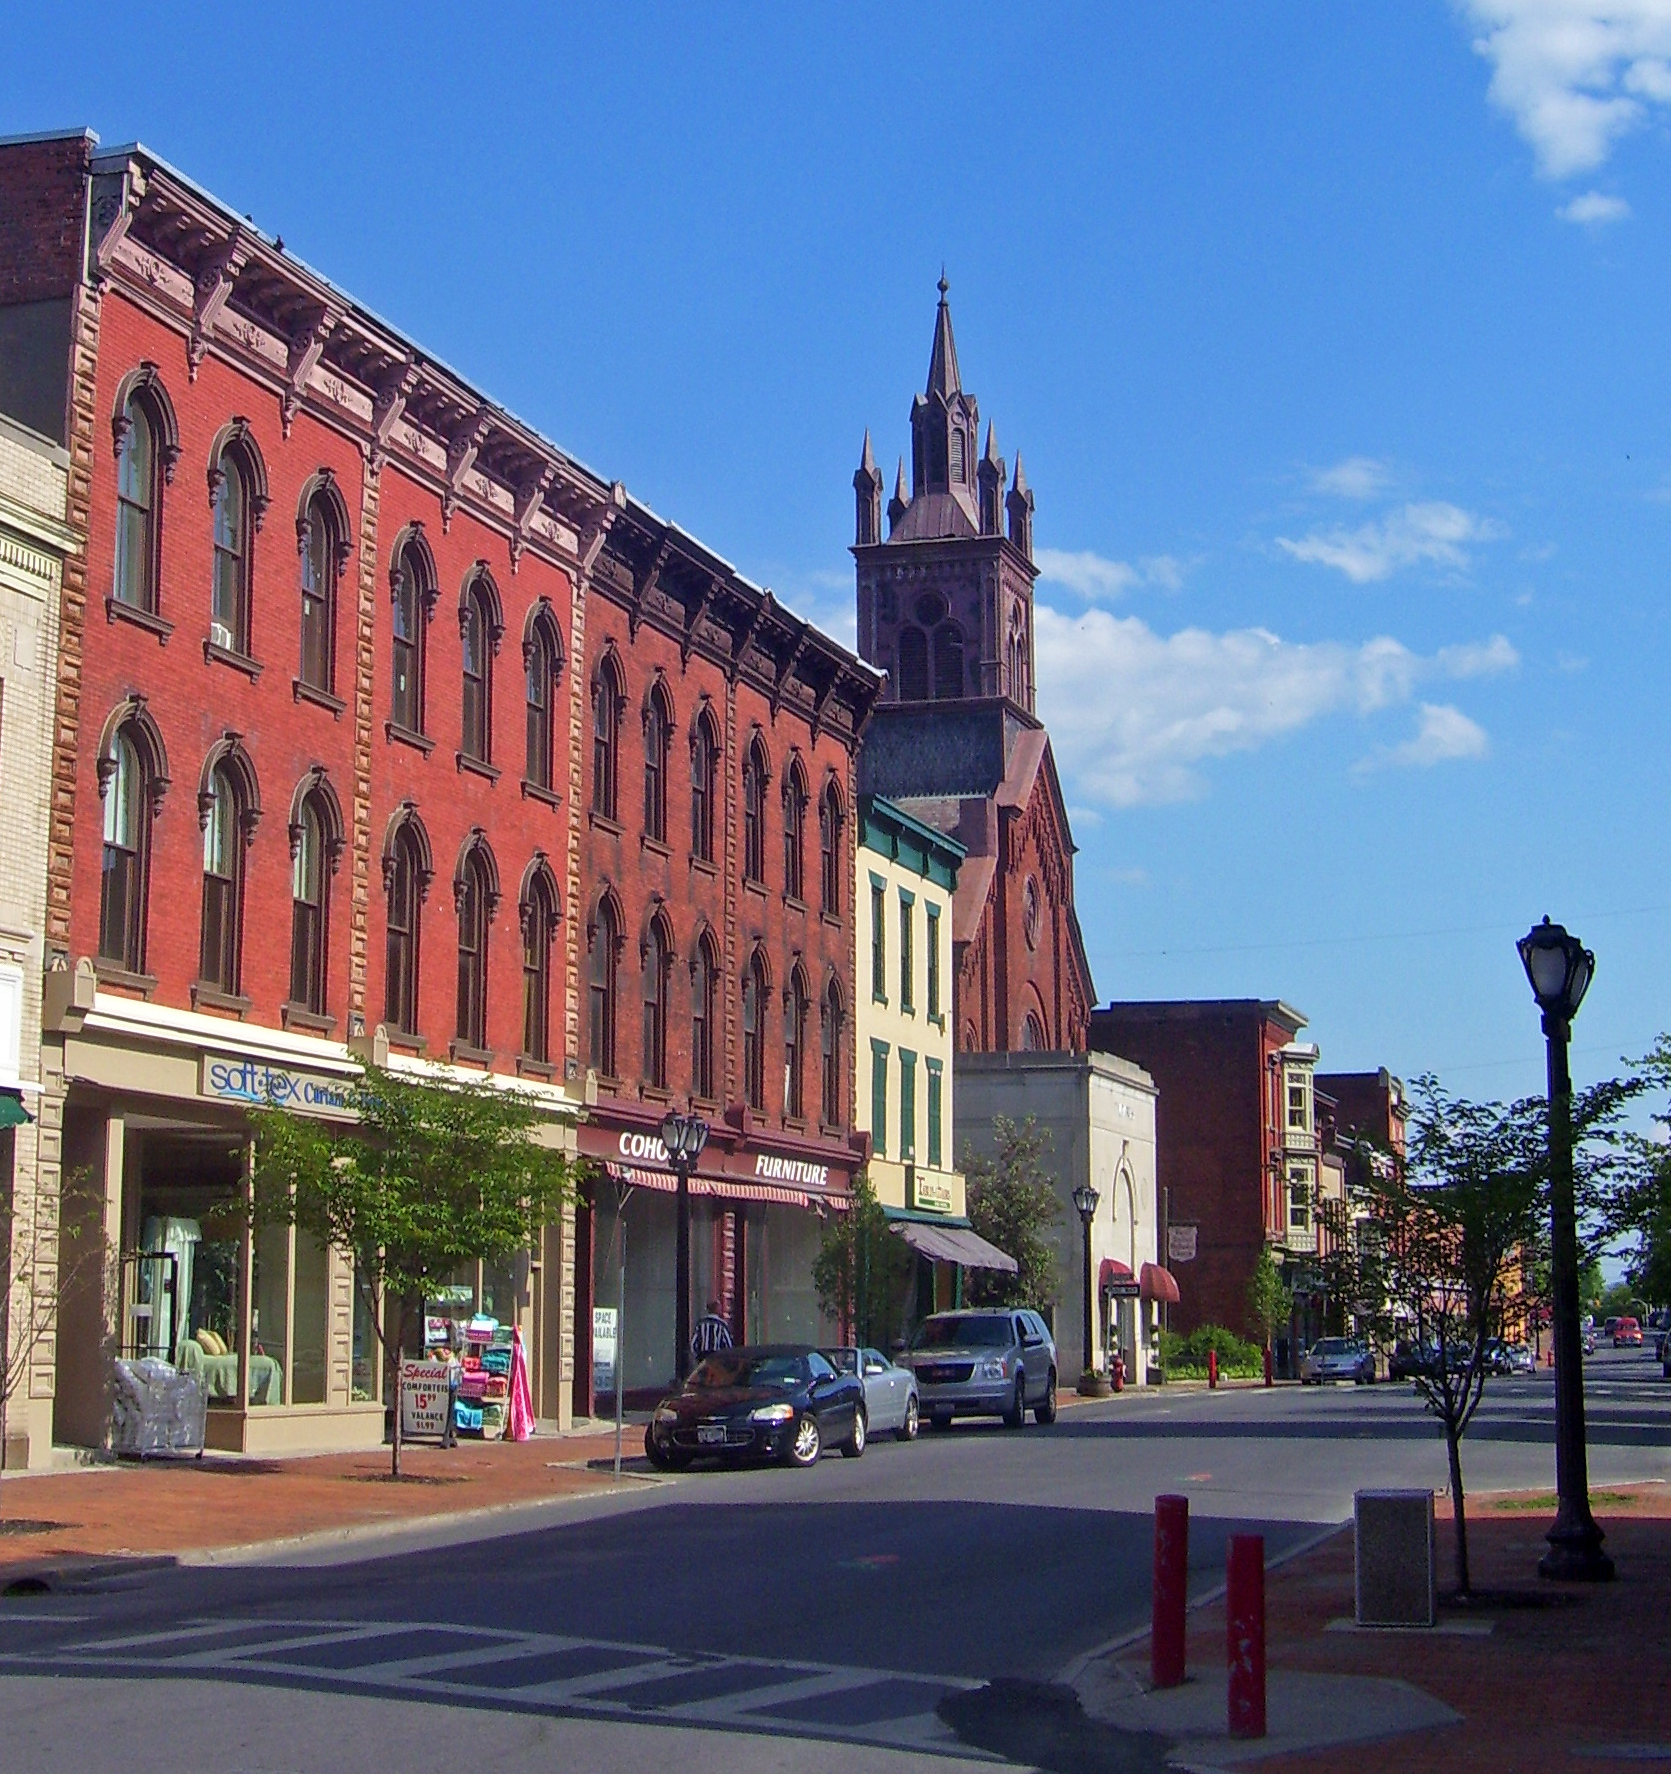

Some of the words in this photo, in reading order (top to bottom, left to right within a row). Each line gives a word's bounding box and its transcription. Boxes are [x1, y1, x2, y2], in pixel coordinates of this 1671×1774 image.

[619, 1132, 688, 1162] COHO
[755, 1154, 829, 1186] FURNITURE
[404, 1364, 448, 1380] Special
